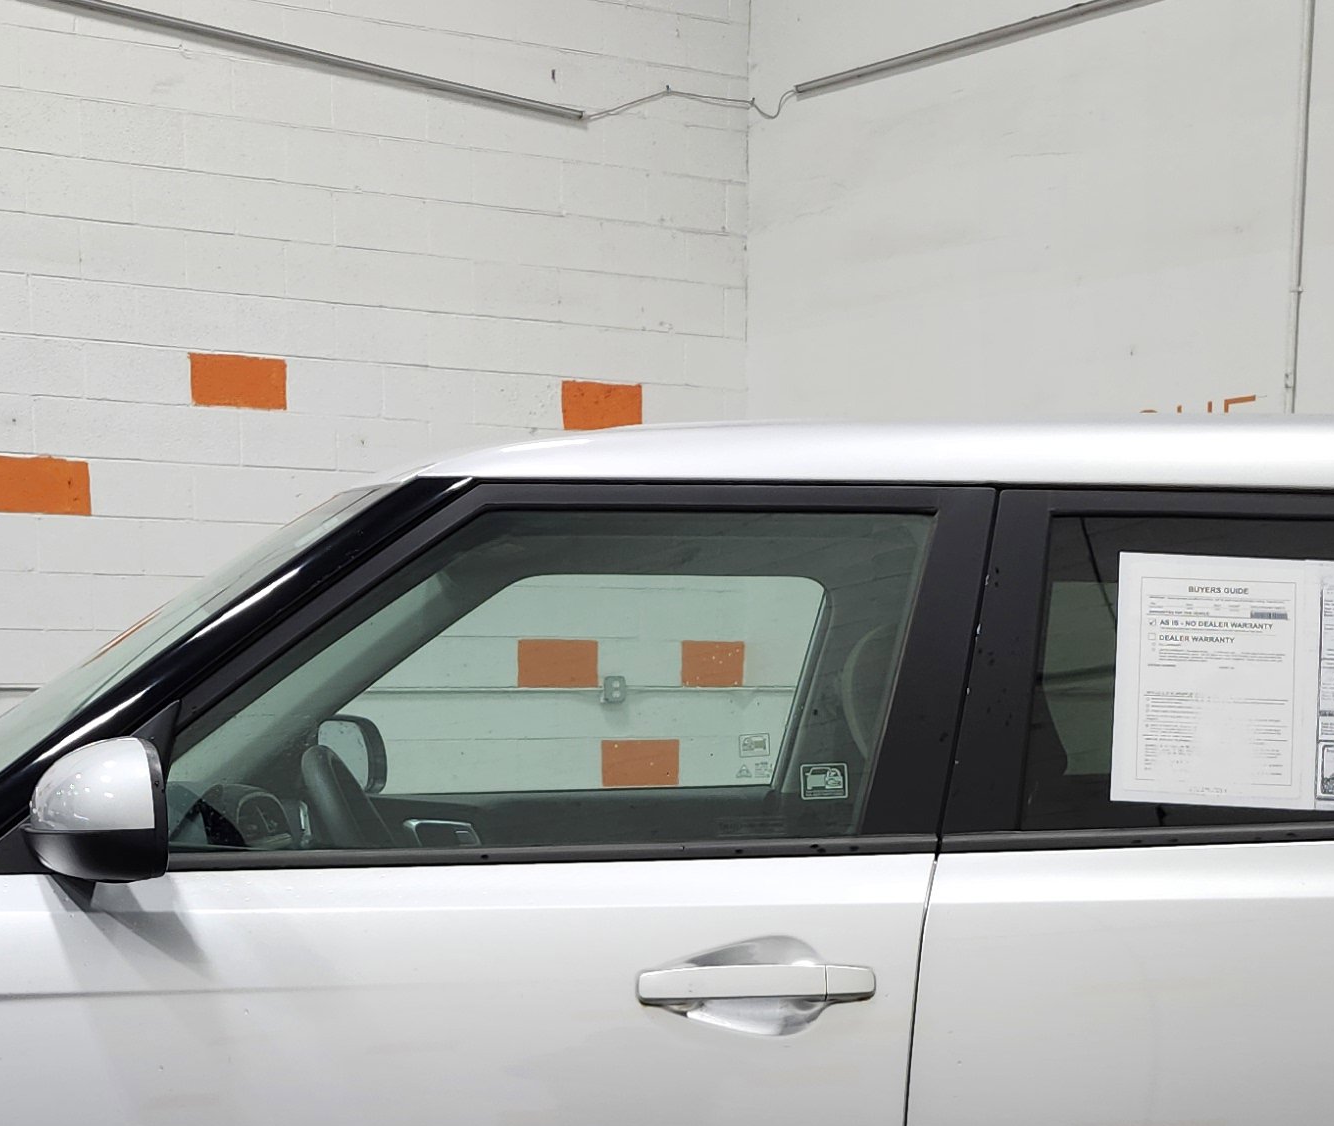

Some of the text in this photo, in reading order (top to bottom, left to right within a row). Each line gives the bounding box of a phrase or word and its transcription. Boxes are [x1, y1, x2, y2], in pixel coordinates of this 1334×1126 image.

[1188, 586, 1249, 595] BUYERS GUIDE
[1198, 621, 1229, 629] DEALER
[1230, 622, 1273, 630] WARRANTY
[1159, 634, 1235, 643] DEALER WARRANTY
